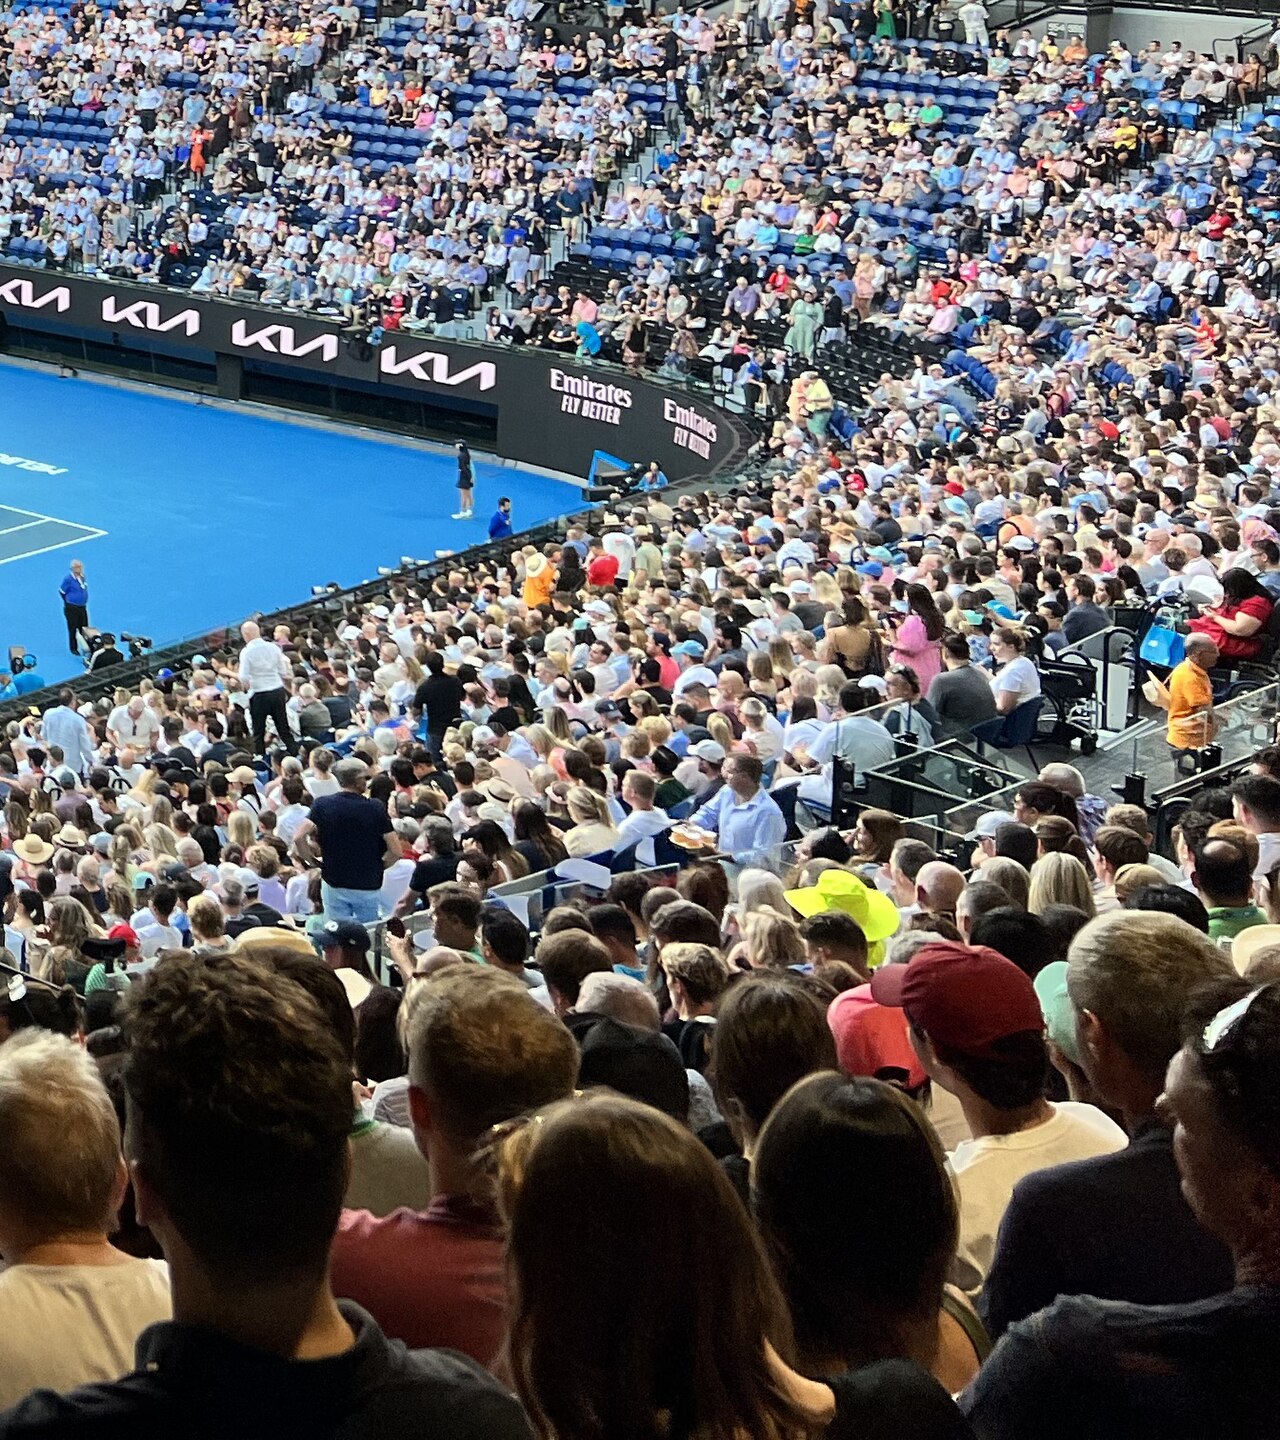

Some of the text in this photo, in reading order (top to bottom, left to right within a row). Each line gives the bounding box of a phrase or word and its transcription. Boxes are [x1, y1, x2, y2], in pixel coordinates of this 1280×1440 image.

[102, 295, 200, 337] KIA
[231, 318, 338, 362] KIA
[380, 345, 496, 391] KIA
[550, 368, 632, 408] Emirates
[561, 394, 621, 425] FLY BETTER
[664, 397, 717, 442] Emirates
[673, 426, 710, 460] FLY BETTER
